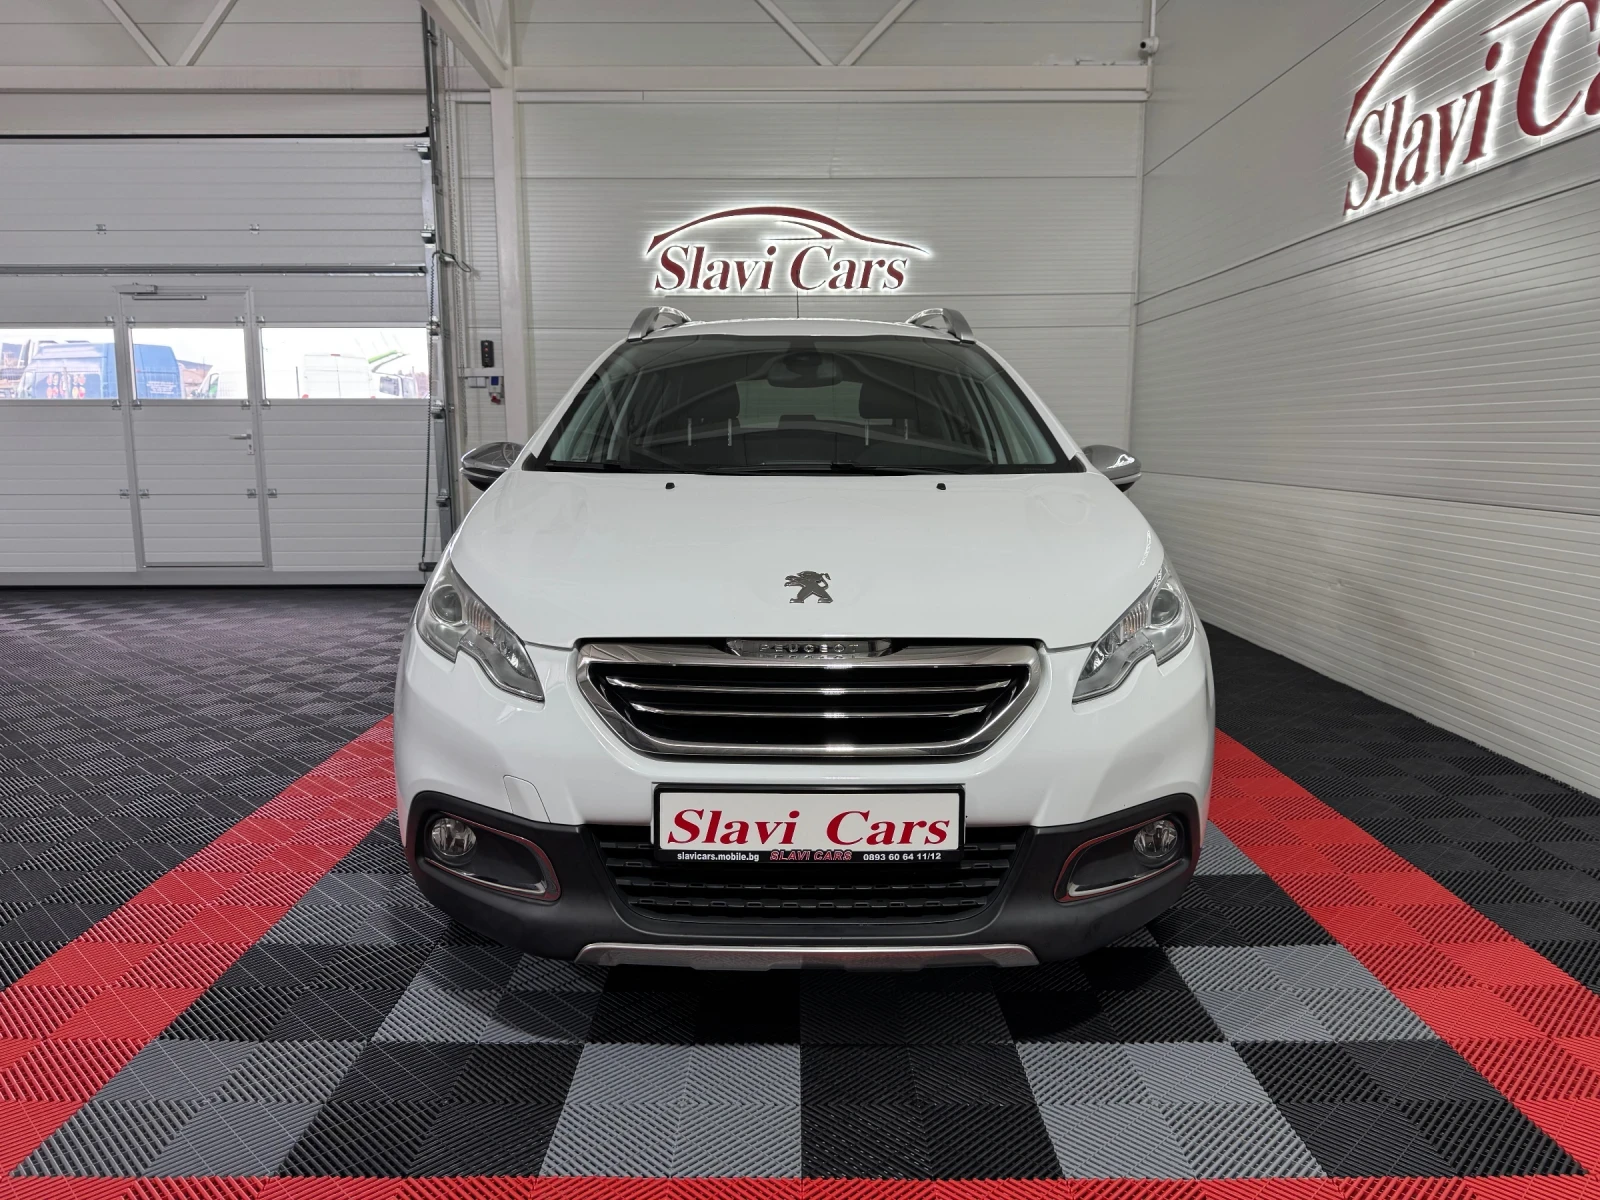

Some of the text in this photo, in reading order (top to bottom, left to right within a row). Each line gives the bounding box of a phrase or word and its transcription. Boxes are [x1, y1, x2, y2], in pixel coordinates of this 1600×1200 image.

[1343, 42, 1502, 216] Slavi
[654, 245, 908, 291] Slavi Cars
[759, 643, 859, 653] PEUGEOT
[667, 808, 950, 846] Slavi Cars
[677, 851, 760, 862] slavicars.mobile.bg
[769, 850, 853, 861] SLAVI CARS
[863, 852, 942, 861] 0893 60 64 11/12
